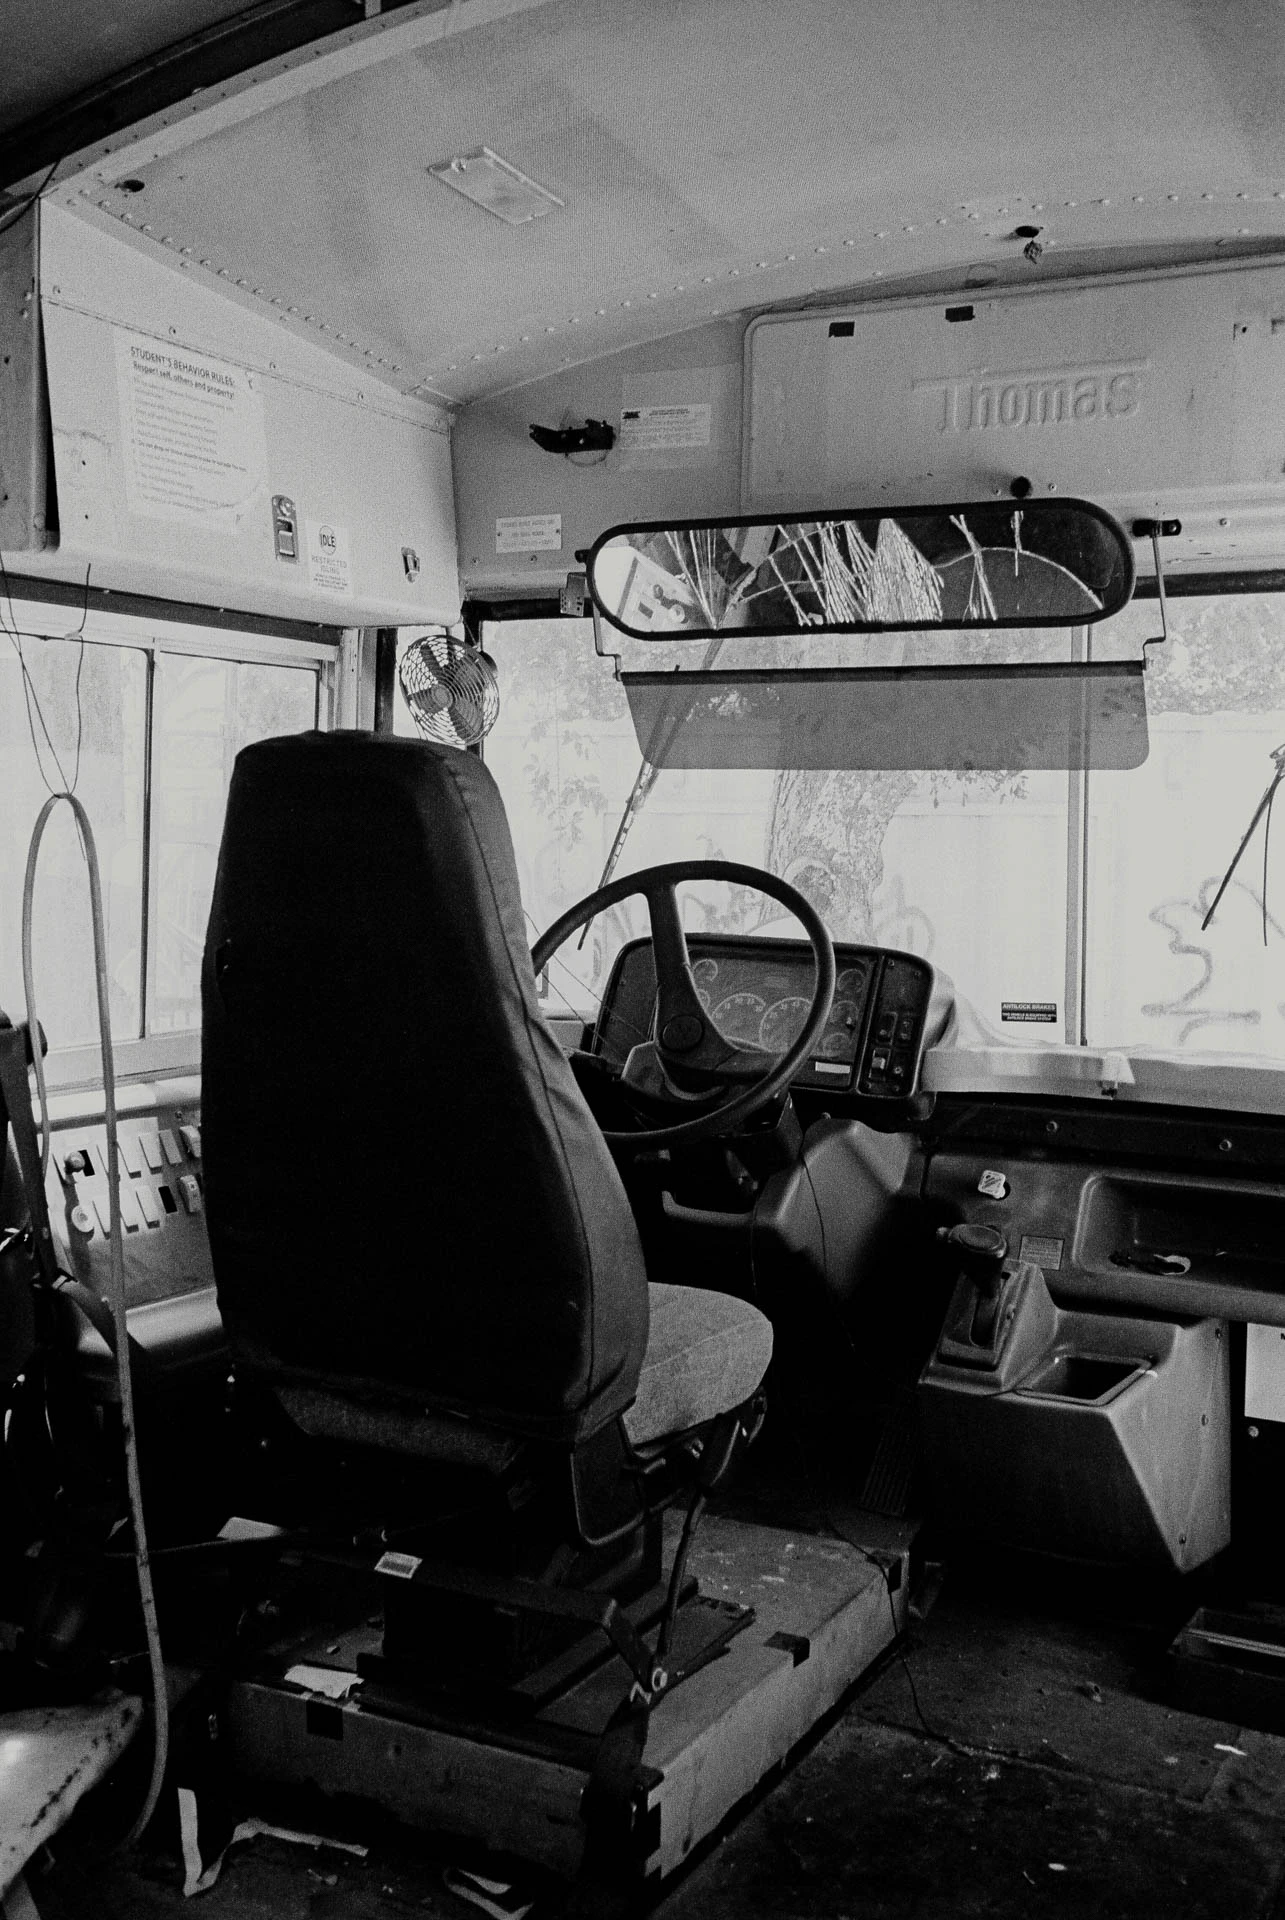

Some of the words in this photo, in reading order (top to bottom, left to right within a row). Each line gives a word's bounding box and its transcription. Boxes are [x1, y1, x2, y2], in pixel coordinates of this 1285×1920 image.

[130, 346, 172, 367] STUDENT'S
[173, 360, 210, 379] BEHAVIOR
[133, 360, 158, 376] Respect
[173, 374, 194, 387] others
[194, 380, 206, 391] and
[913, 357, 1150, 434] Thomas
[319, 534, 336, 548] IDLE
